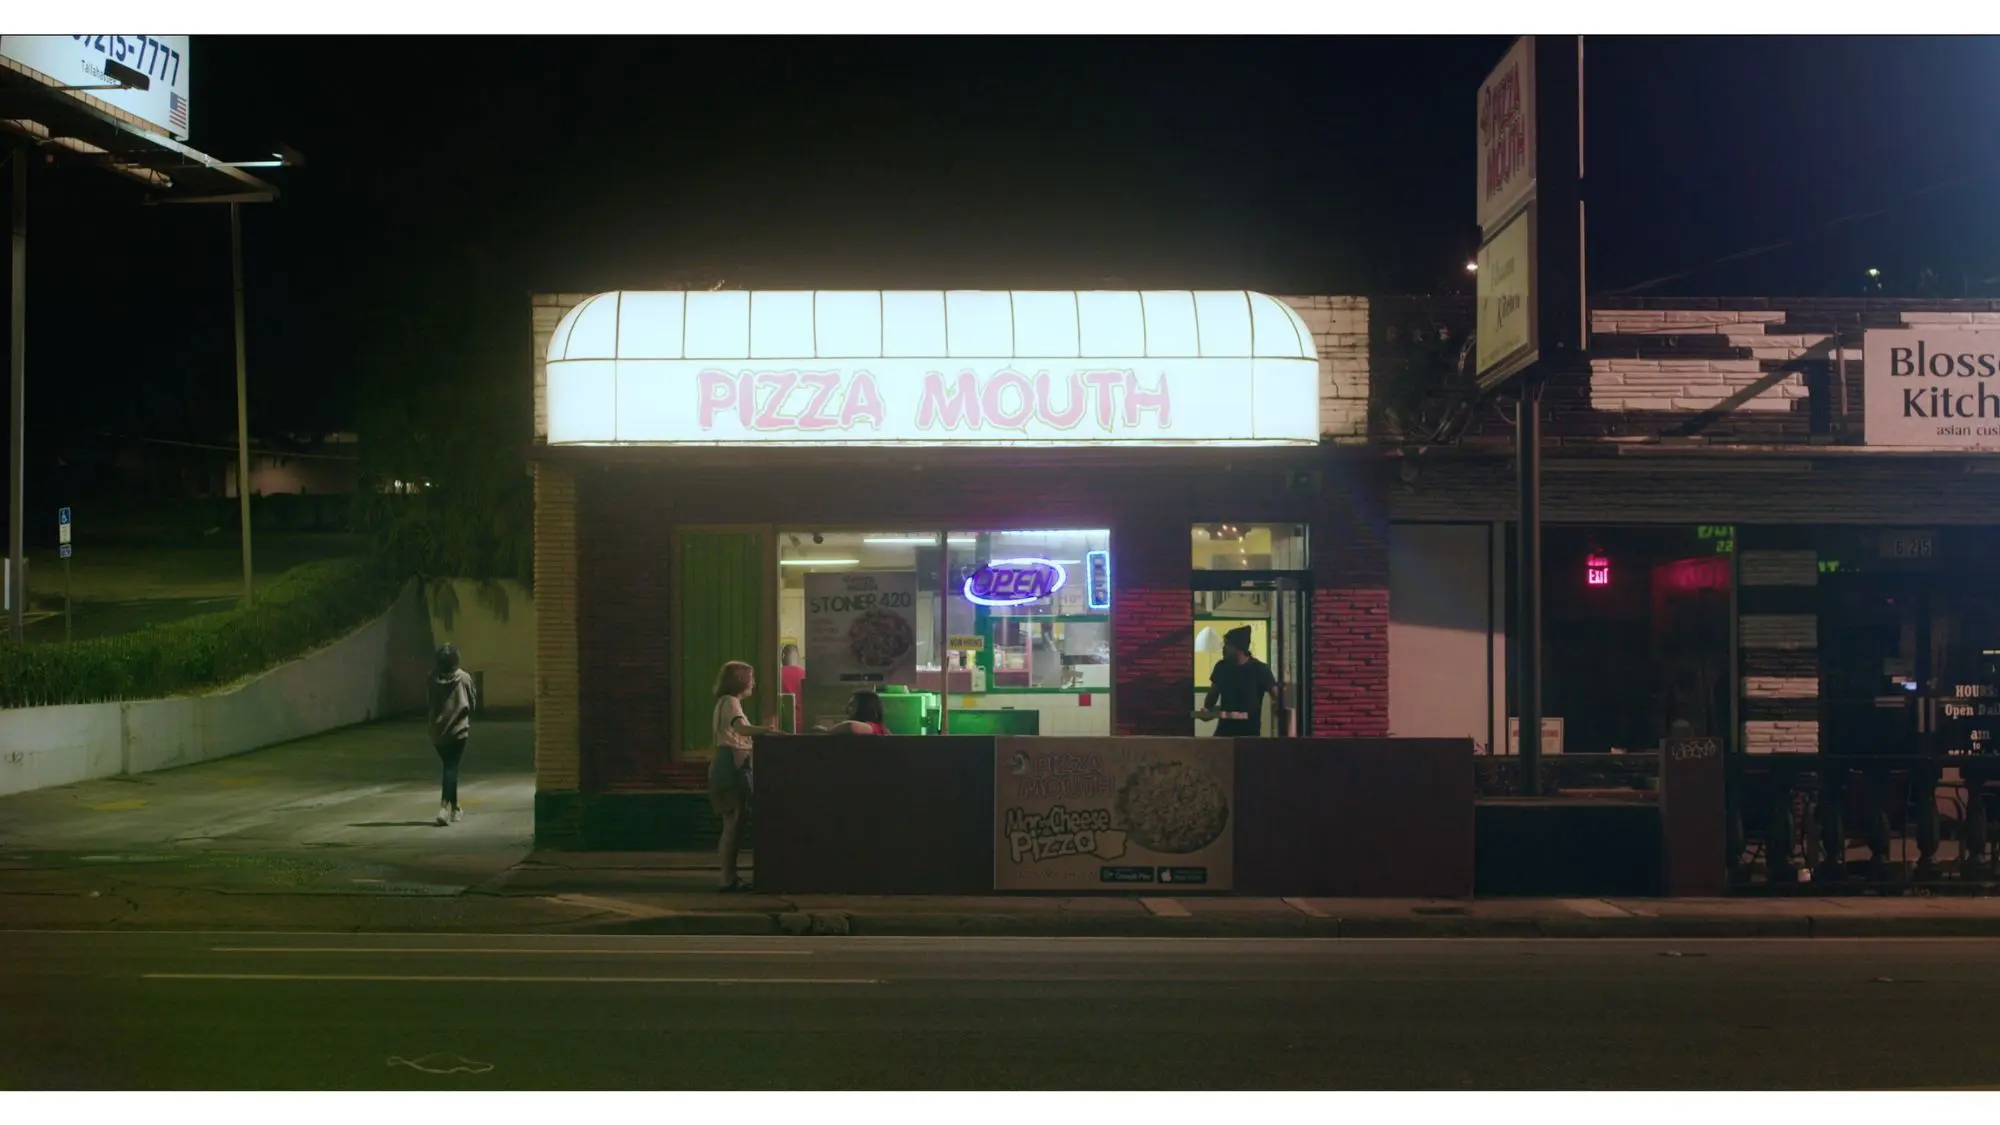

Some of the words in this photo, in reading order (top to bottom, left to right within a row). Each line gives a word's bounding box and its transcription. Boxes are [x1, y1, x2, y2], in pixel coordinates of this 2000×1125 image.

[696, 368, 887, 431] PIZZA
[914, 365, 1172, 434] MOUTH
[1936, 424, 1971, 436] asian
[972, 568, 1054, 597] OPEN
[1588, 567, 1608, 584] EXIT
[811, 594, 877, 613] STONER
[880, 592, 912, 608] 420
[1944, 703, 1975, 720] Open
[1034, 752, 1104, 776] PIZZA
[1018, 775, 1116, 800] MOUTH
